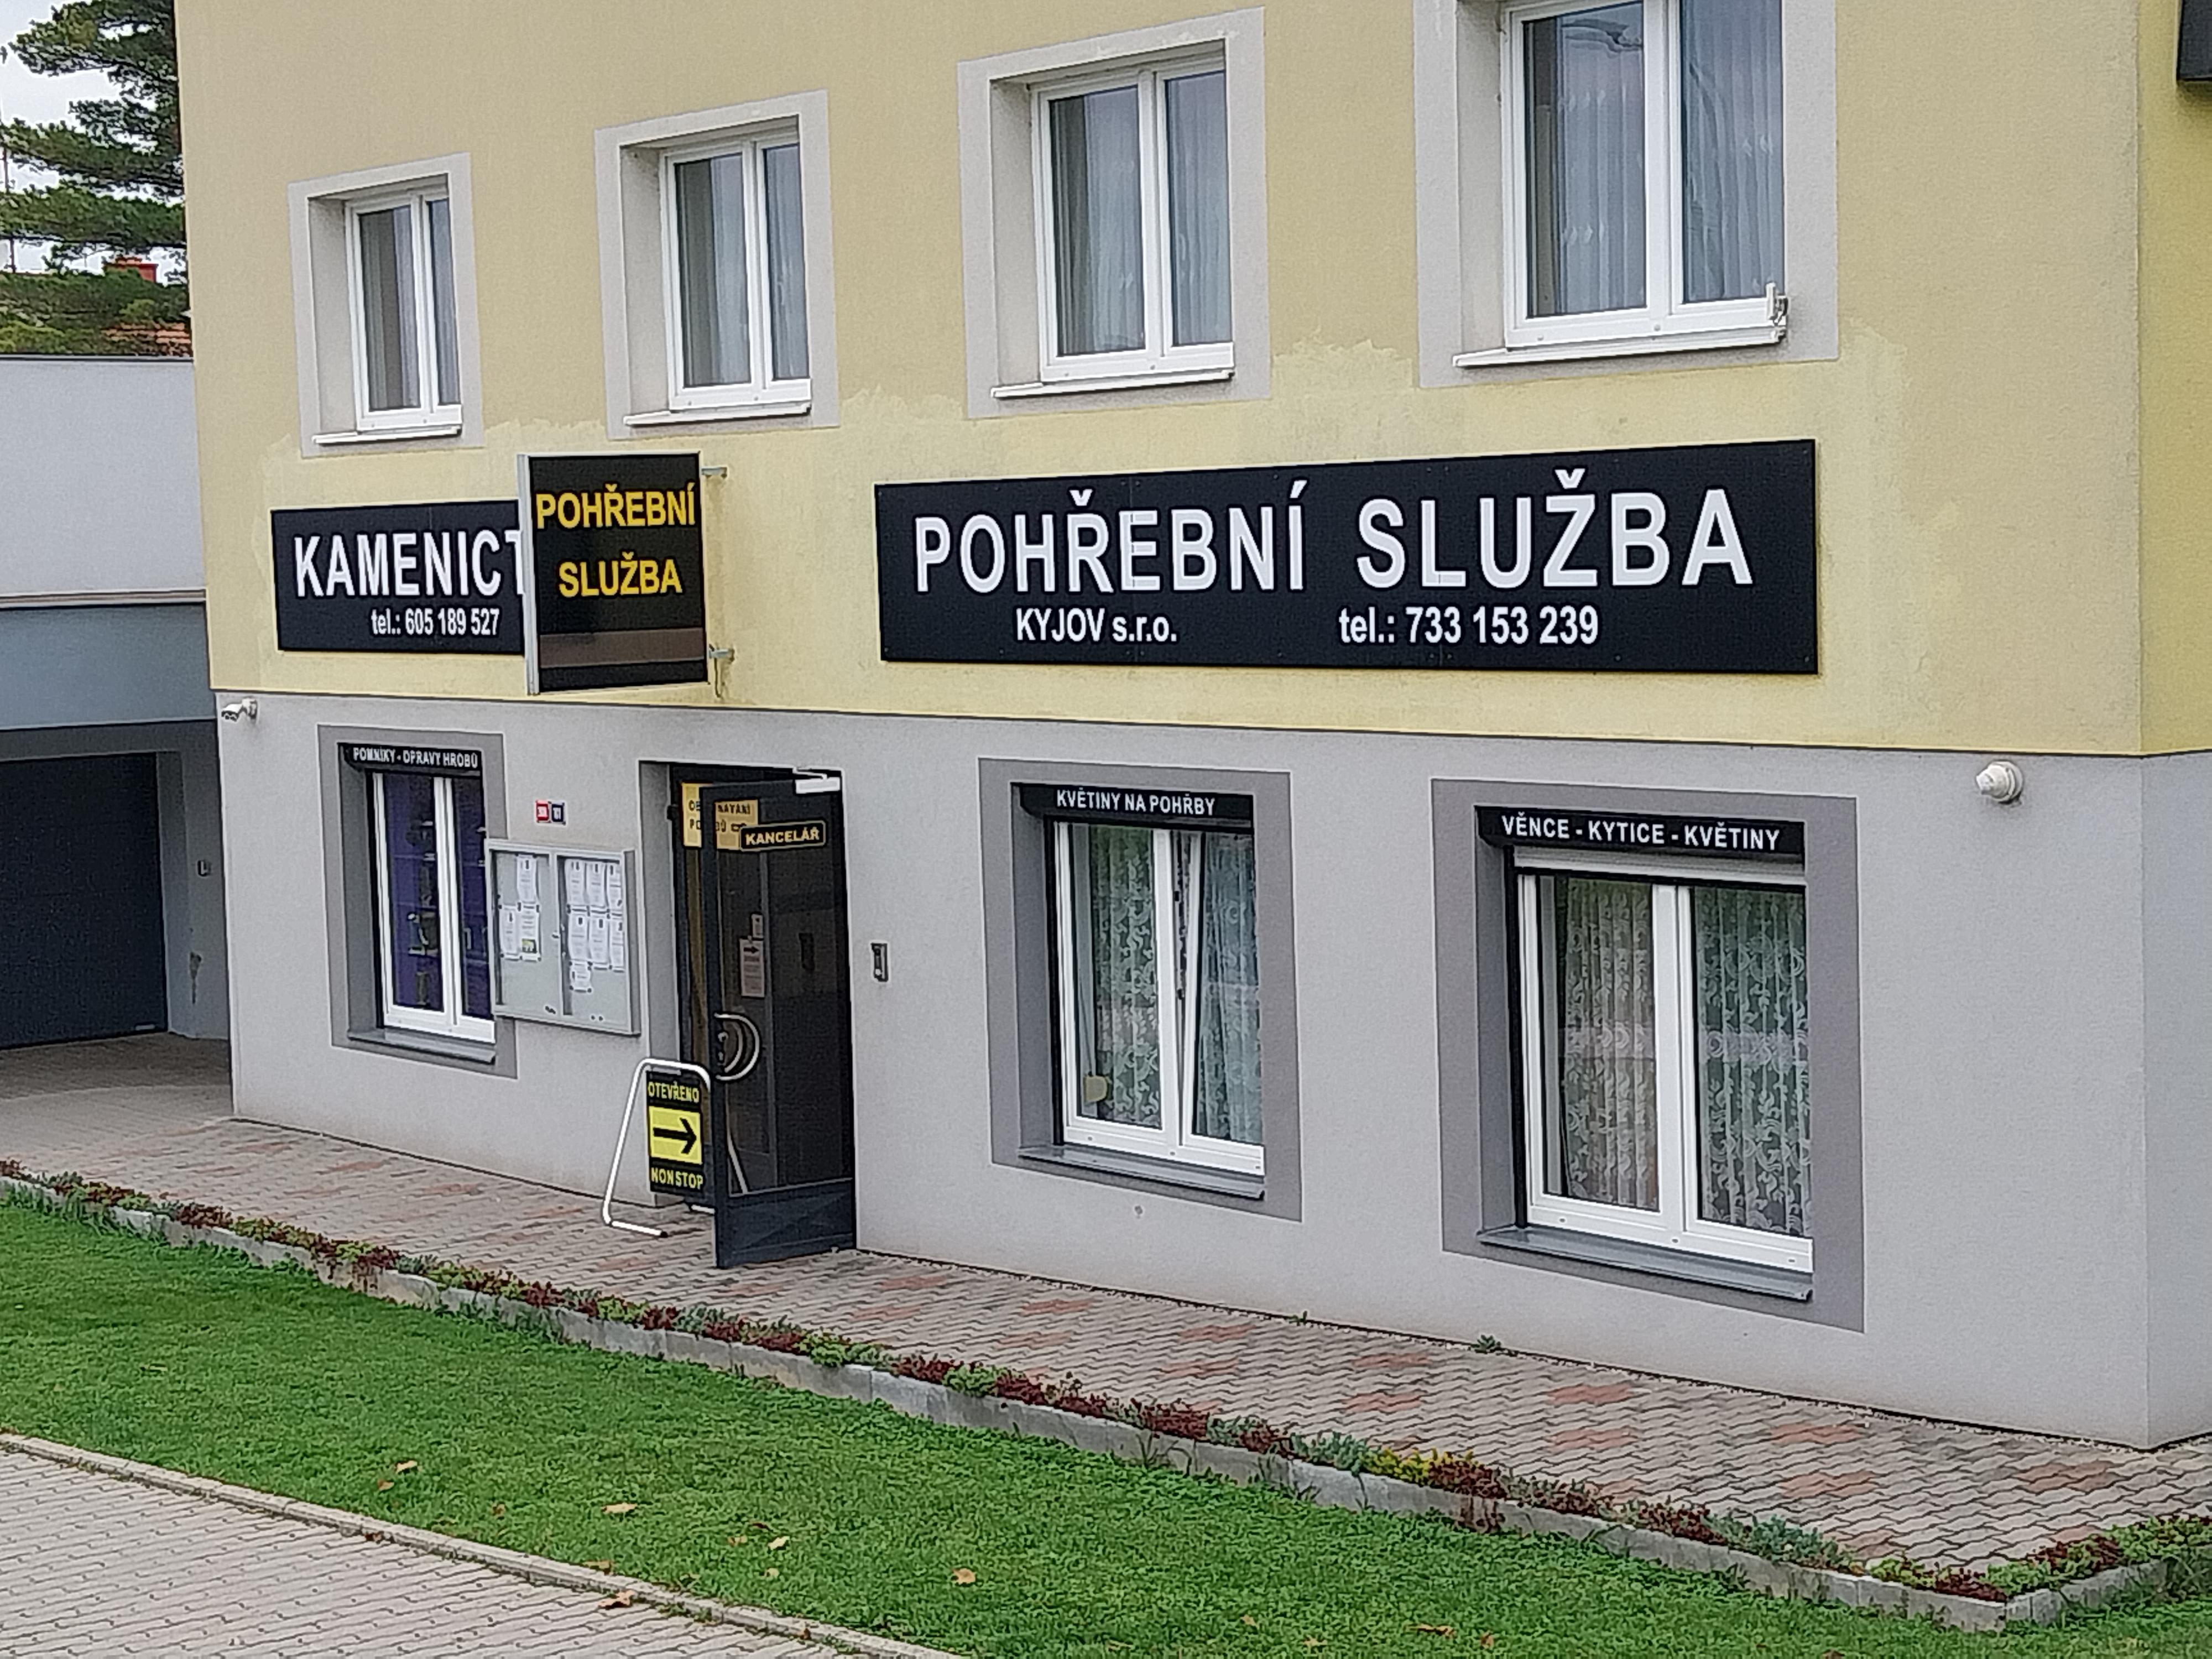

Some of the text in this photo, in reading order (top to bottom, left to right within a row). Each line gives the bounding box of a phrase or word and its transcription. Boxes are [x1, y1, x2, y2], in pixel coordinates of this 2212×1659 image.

[536, 482, 695, 529] POHŘEBNÍ
[912, 468, 1753, 593] POHŘEBNÍ SLUŽBA
[559, 551, 682, 597] SLUŽBA
[371, 608, 500, 635] tel.: 605 189 527
[1016, 608, 1177, 642] KYJOV s.r.o.
[1339, 605, 1598, 644] tel.: 733 153 239
[403, 750, 441, 765] OPRAVY
[1057, 787, 1215, 816] KVĚTINY NA POHŘBY
[1501, 811, 1570, 839] VĚNCE
[1588, 820, 1665, 844] KYTICE
[1684, 821, 1780, 851] KVĚTINY
